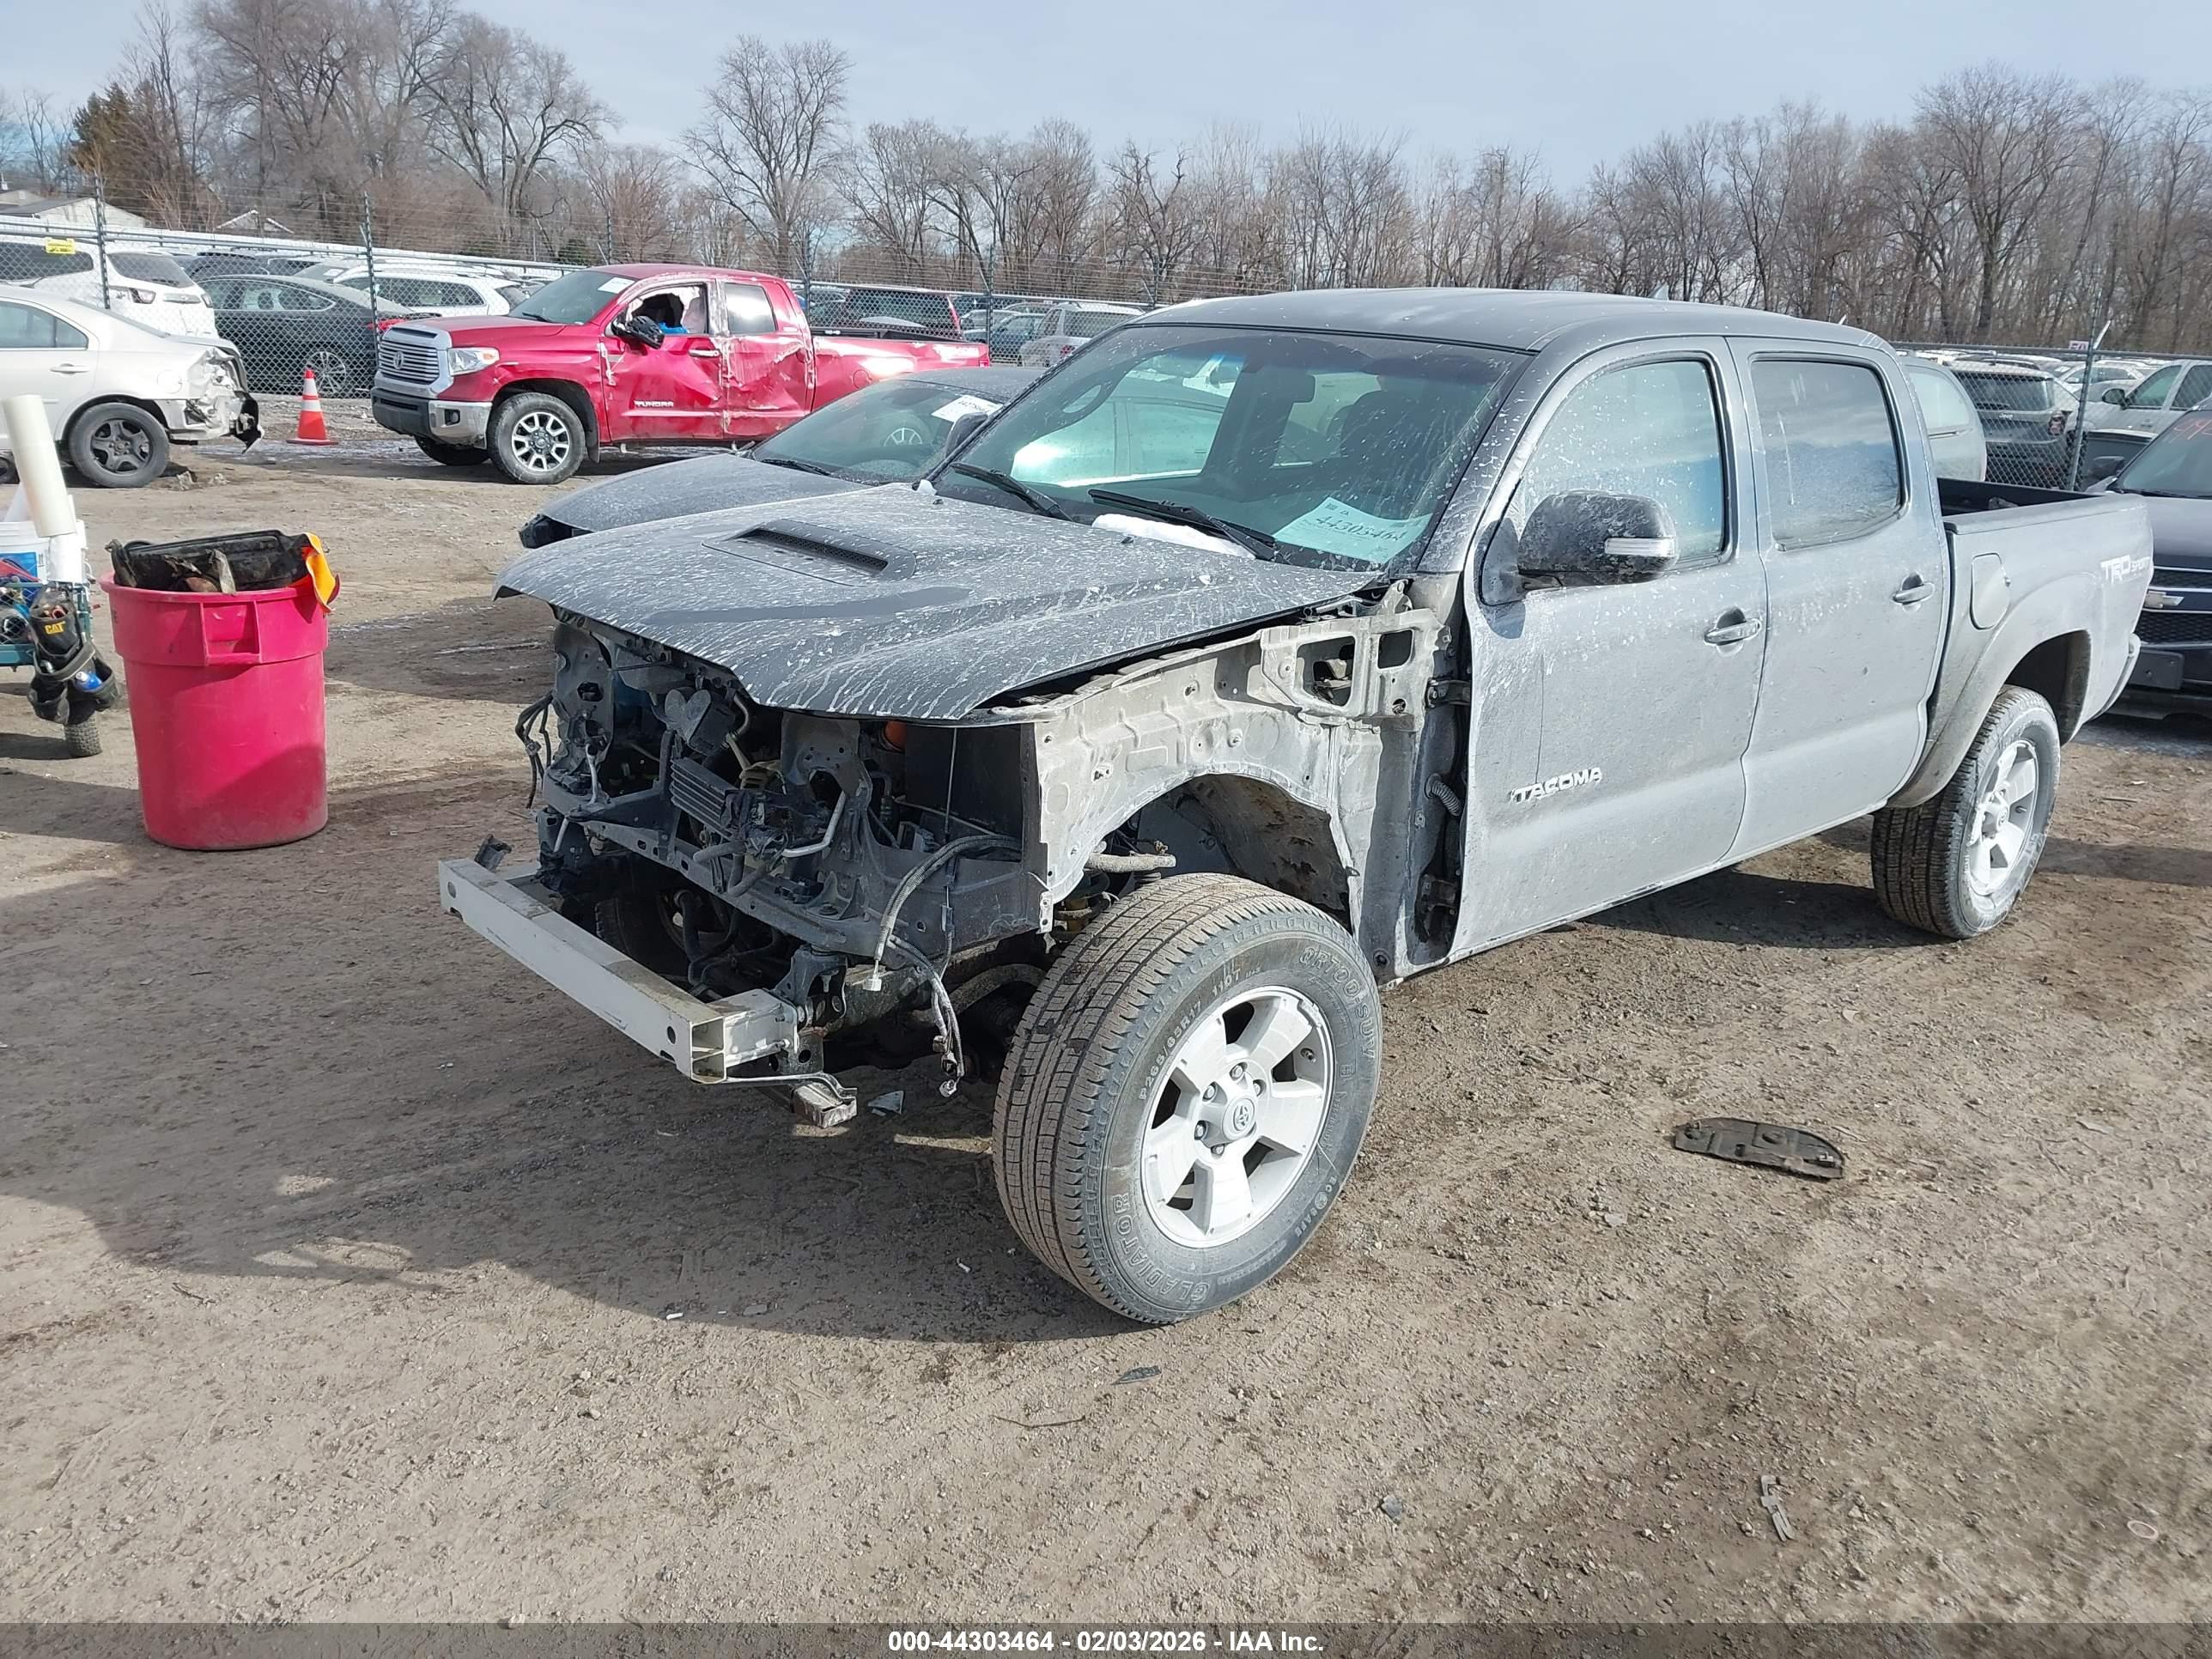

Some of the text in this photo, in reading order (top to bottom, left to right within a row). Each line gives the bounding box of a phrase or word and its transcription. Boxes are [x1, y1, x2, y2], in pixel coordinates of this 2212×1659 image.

[2100, 555, 2130, 585] TRD
[45, 622, 65, 635] CAT
[1510, 767, 1601, 804] TACOMA
[1112, 1193, 1210, 1304] GLADIATOR
